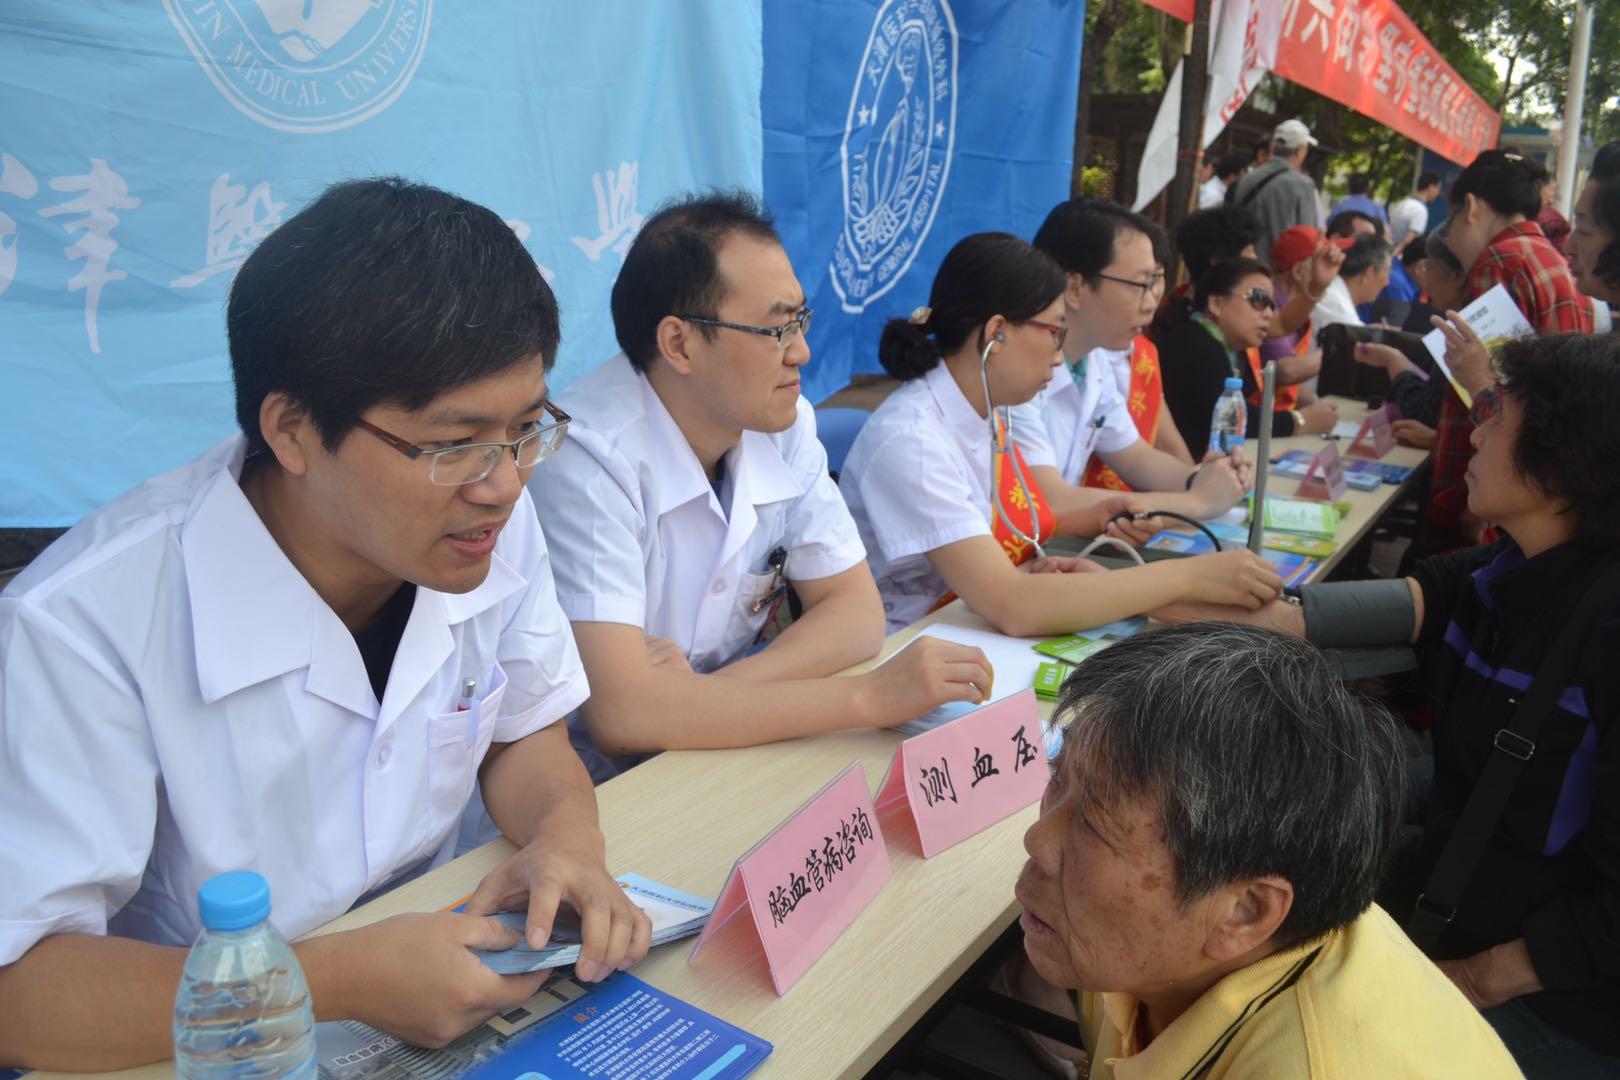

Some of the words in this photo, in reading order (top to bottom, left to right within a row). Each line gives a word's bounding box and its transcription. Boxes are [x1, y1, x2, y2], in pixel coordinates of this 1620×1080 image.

[227, 40, 327, 107] MEDICAL
[336, 0, 419, 101] UNIVERS
[910, 160, 943, 235] HOSPITAL
[919, 725, 1038, 808] 测血压
[767, 806, 874, 928] 脑血管病咨询
